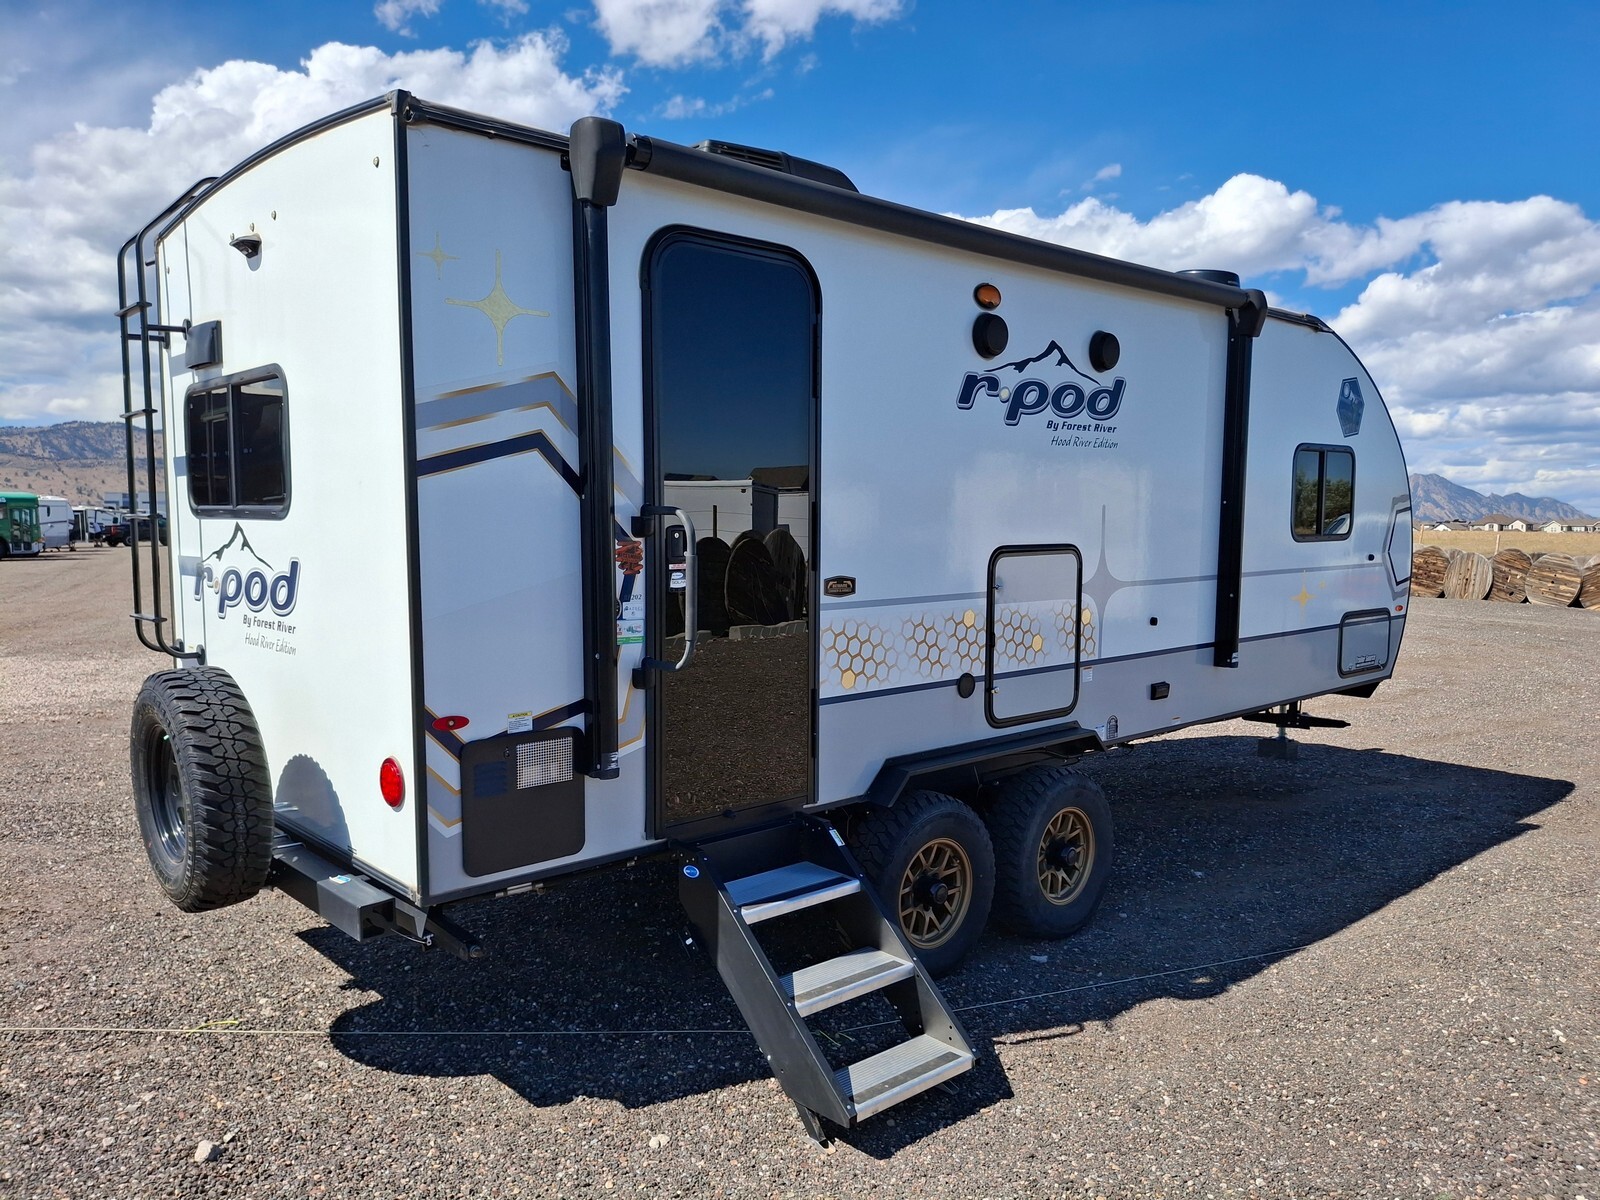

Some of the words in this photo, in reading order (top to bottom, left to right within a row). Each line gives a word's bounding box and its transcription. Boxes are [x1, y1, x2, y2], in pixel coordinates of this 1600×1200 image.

[1046, 420, 1059, 431] By
[1061, 421, 1092, 432] Forest
[1093, 423, 1117, 433] River
[1050, 434, 1073, 447] Hood
[1073, 436, 1092, 447] River
[1093, 437, 1119, 449] Edition
[243, 614, 252, 628] By
[253, 616, 275, 631] Forest
[277, 621, 296, 634] River
[245, 632, 260, 647] Hood
[260, 635, 275, 650] River
[275, 638, 297, 656] Edition
